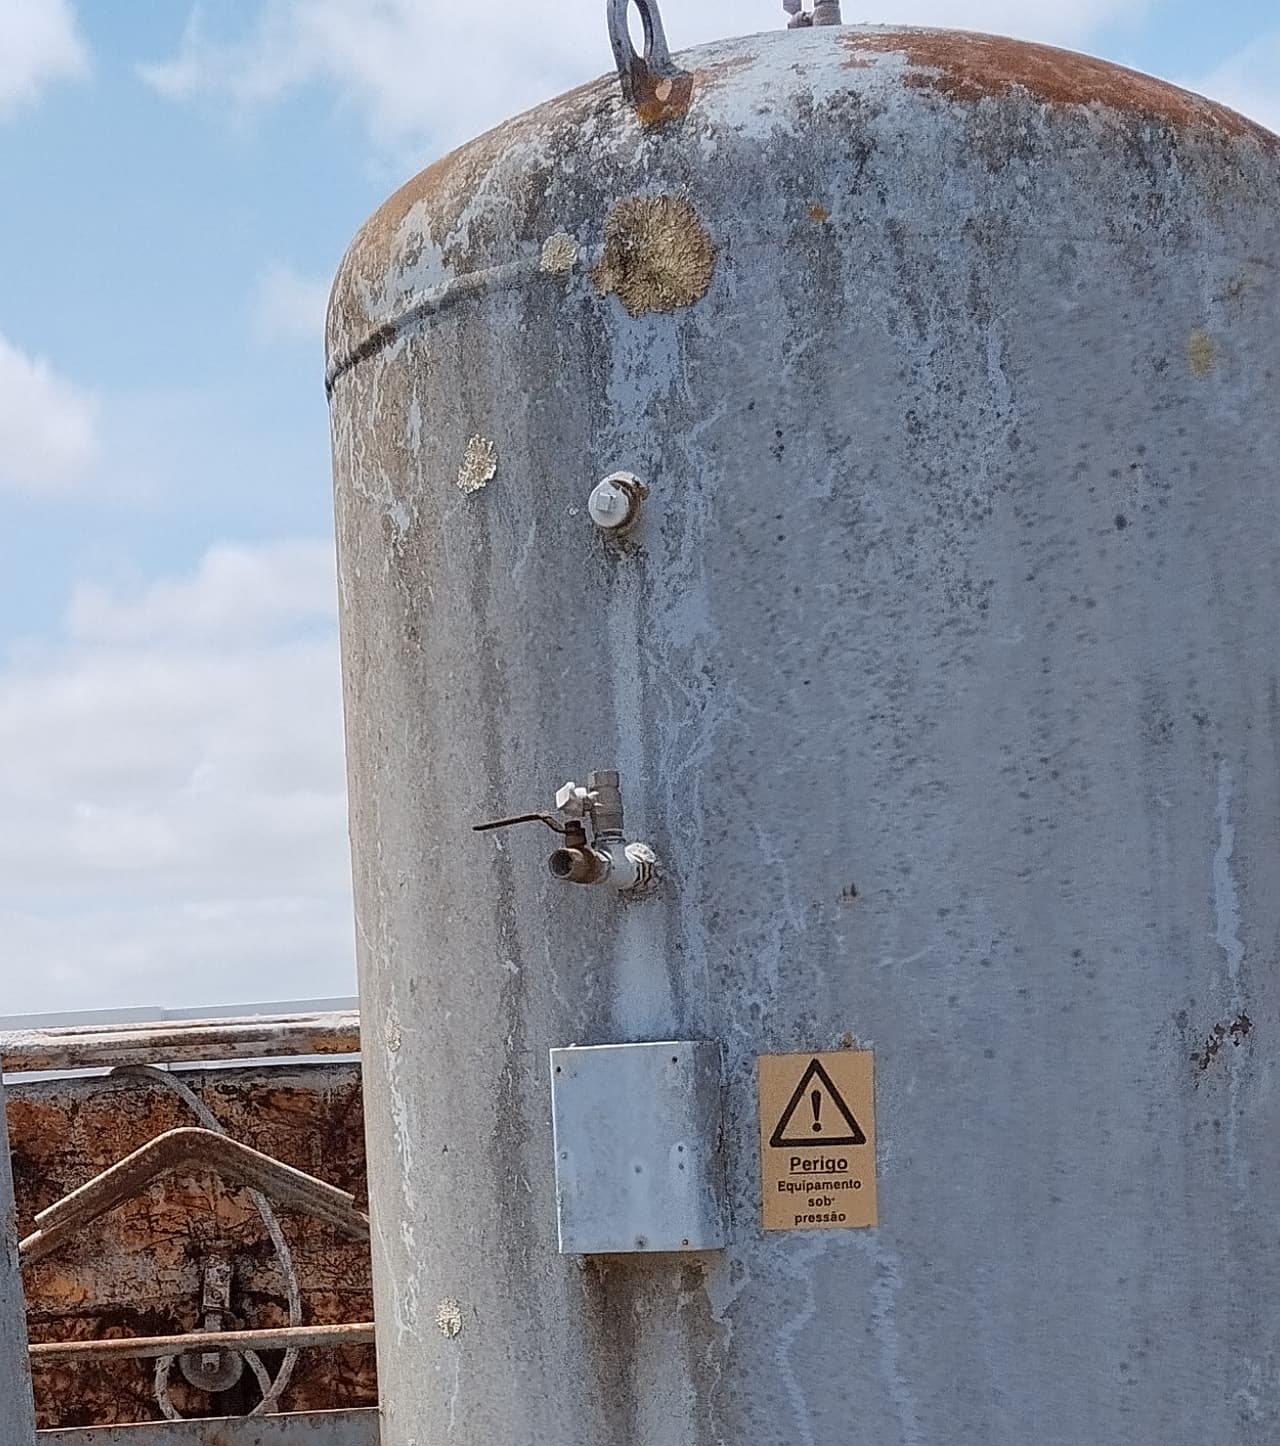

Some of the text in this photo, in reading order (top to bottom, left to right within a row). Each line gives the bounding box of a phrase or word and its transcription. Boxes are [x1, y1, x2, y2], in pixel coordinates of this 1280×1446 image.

[790, 1155, 848, 1173] Perigo
[777, 1179, 862, 1194] Equipamento
[794, 1211, 847, 1226] pressão
